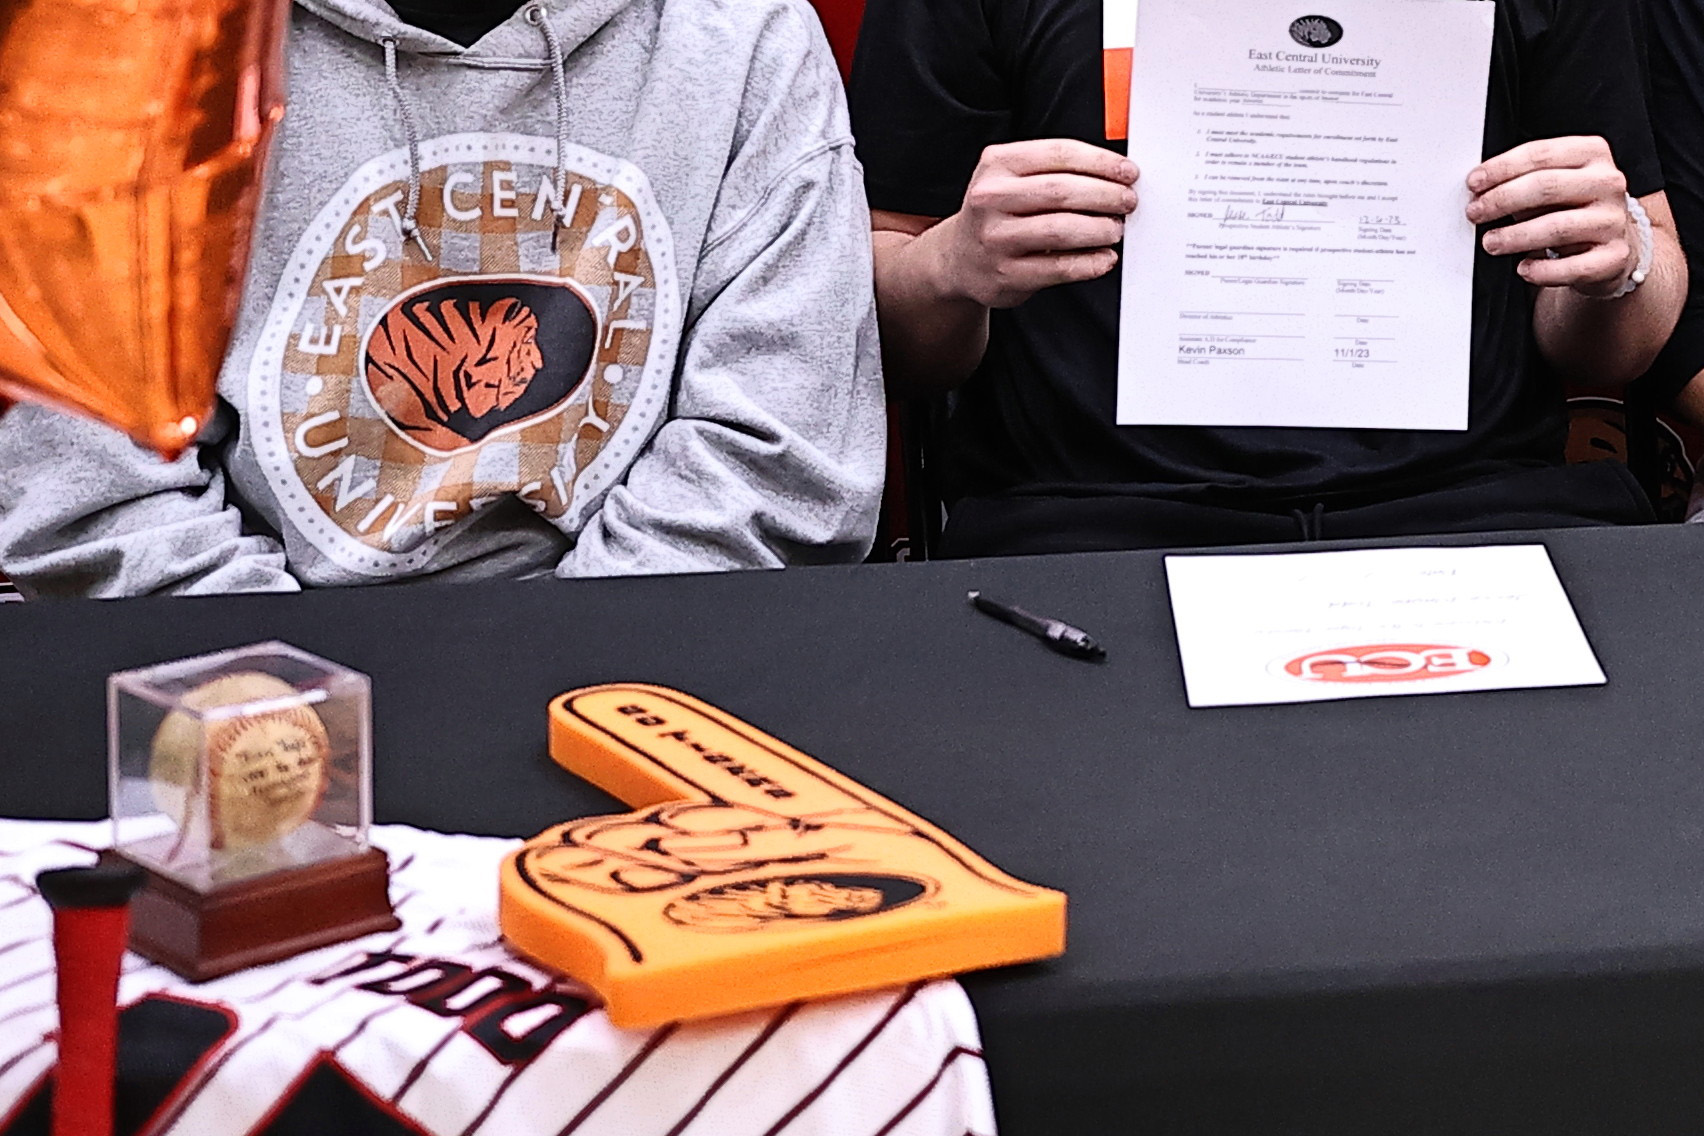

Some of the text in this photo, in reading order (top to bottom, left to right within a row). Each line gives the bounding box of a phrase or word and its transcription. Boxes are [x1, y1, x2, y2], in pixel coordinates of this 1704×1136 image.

[1248, 49, 1381, 68] East Central University
[299, 190, 409, 356] EAST
[1178, 345, 1245, 356] Kevin Paxson
[1334, 348, 1370, 358] 11/1/23
